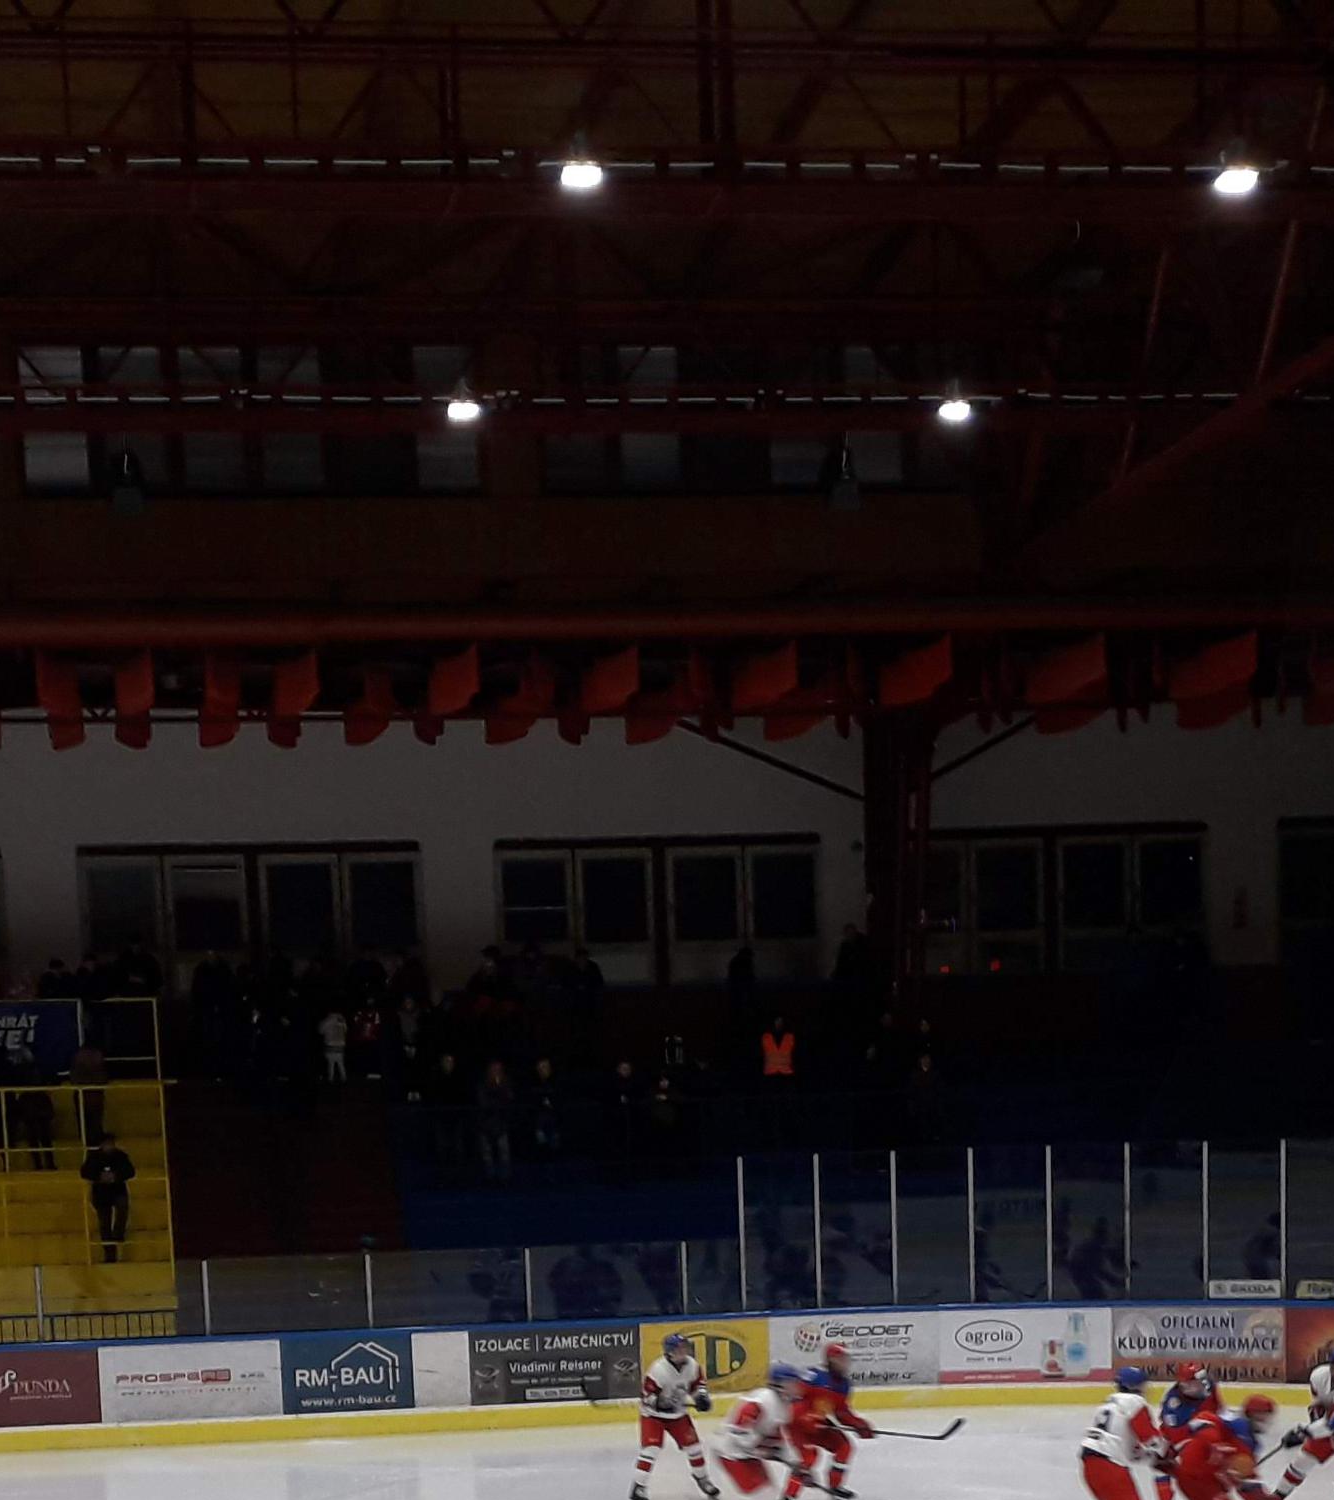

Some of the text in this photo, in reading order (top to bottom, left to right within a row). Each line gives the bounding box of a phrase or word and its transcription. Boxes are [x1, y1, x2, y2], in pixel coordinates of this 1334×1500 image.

[825, 1324, 913, 1338] GEODET
[965, 1329, 1013, 1346] agrola
[474, 1338, 531, 1352] IZOLACE
[1192, 1335, 1279, 1351] INFORMACE
[560, 1359, 602, 1372] Reisner
[294, 1366, 384, 1388] RM-BAU
